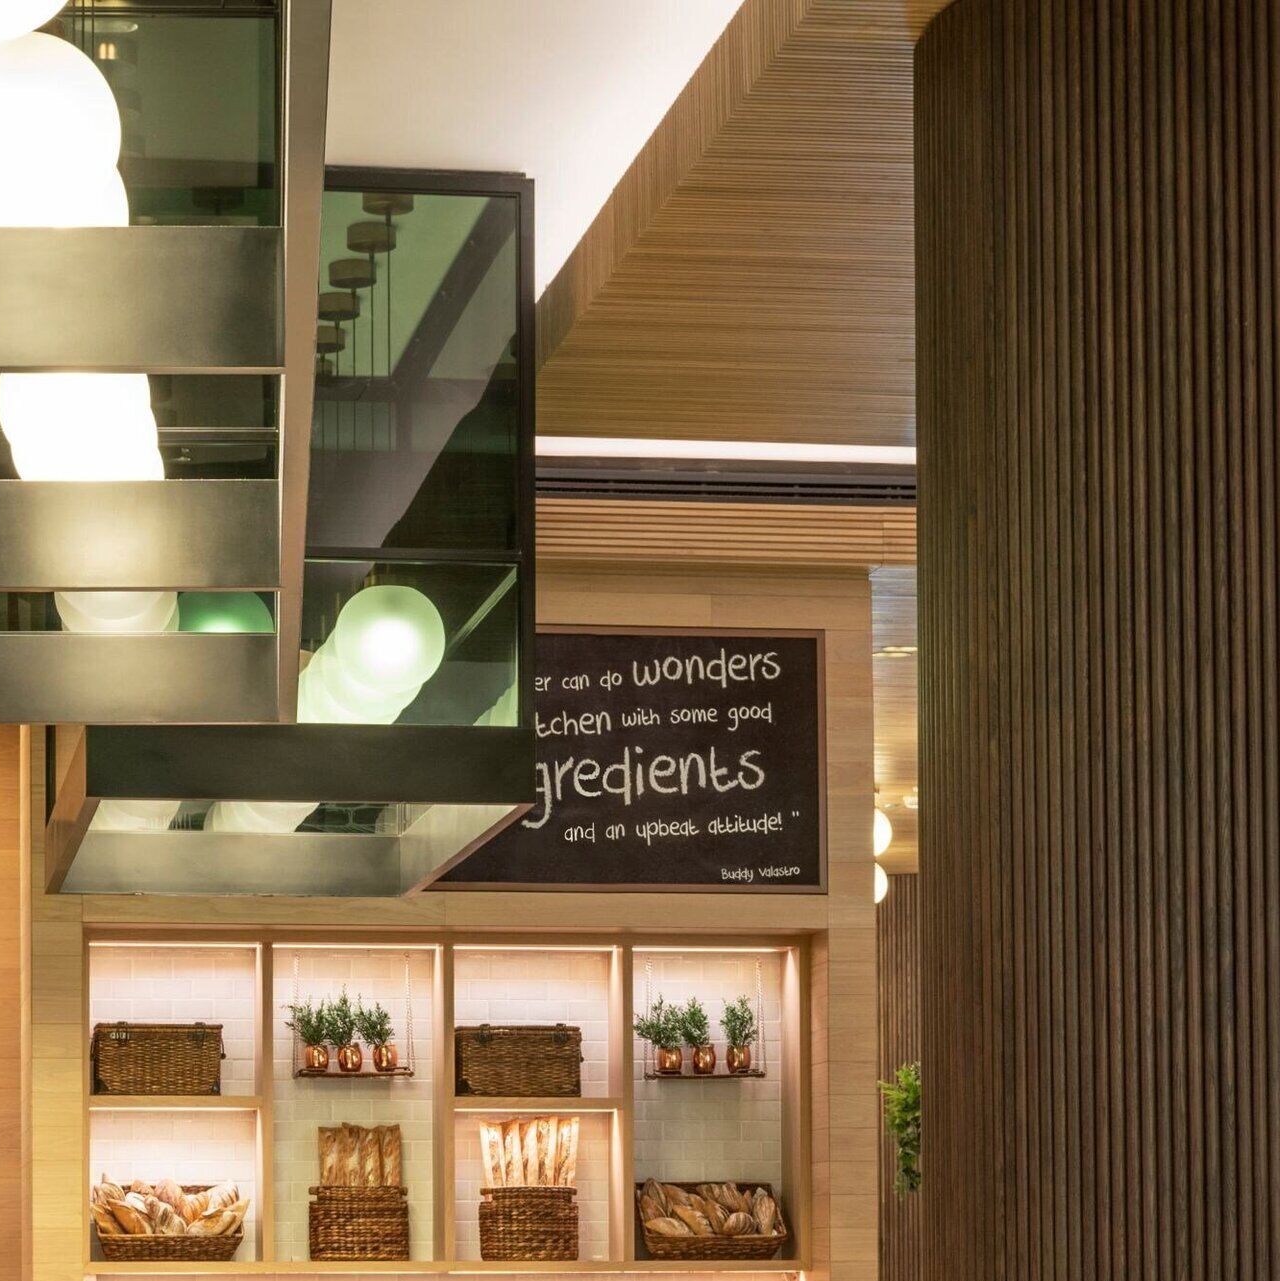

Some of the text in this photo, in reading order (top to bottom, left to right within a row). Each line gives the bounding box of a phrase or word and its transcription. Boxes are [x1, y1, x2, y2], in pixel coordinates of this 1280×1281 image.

[561, 673, 590, 692] can
[599, 669, 623, 692] do
[632, 647, 781, 689] wonders
[621, 707, 661, 727] with
[669, 707, 719, 725] some
[727, 701, 773, 732] good
[521, 745, 766, 830] gredients
[564, 821, 596, 844] and
[605, 823, 626, 841] an
[635, 818, 700, 847] upbeat
[707, 811, 783, 835] attitude!
[720, 865, 801, 883] Buddy Valastro
